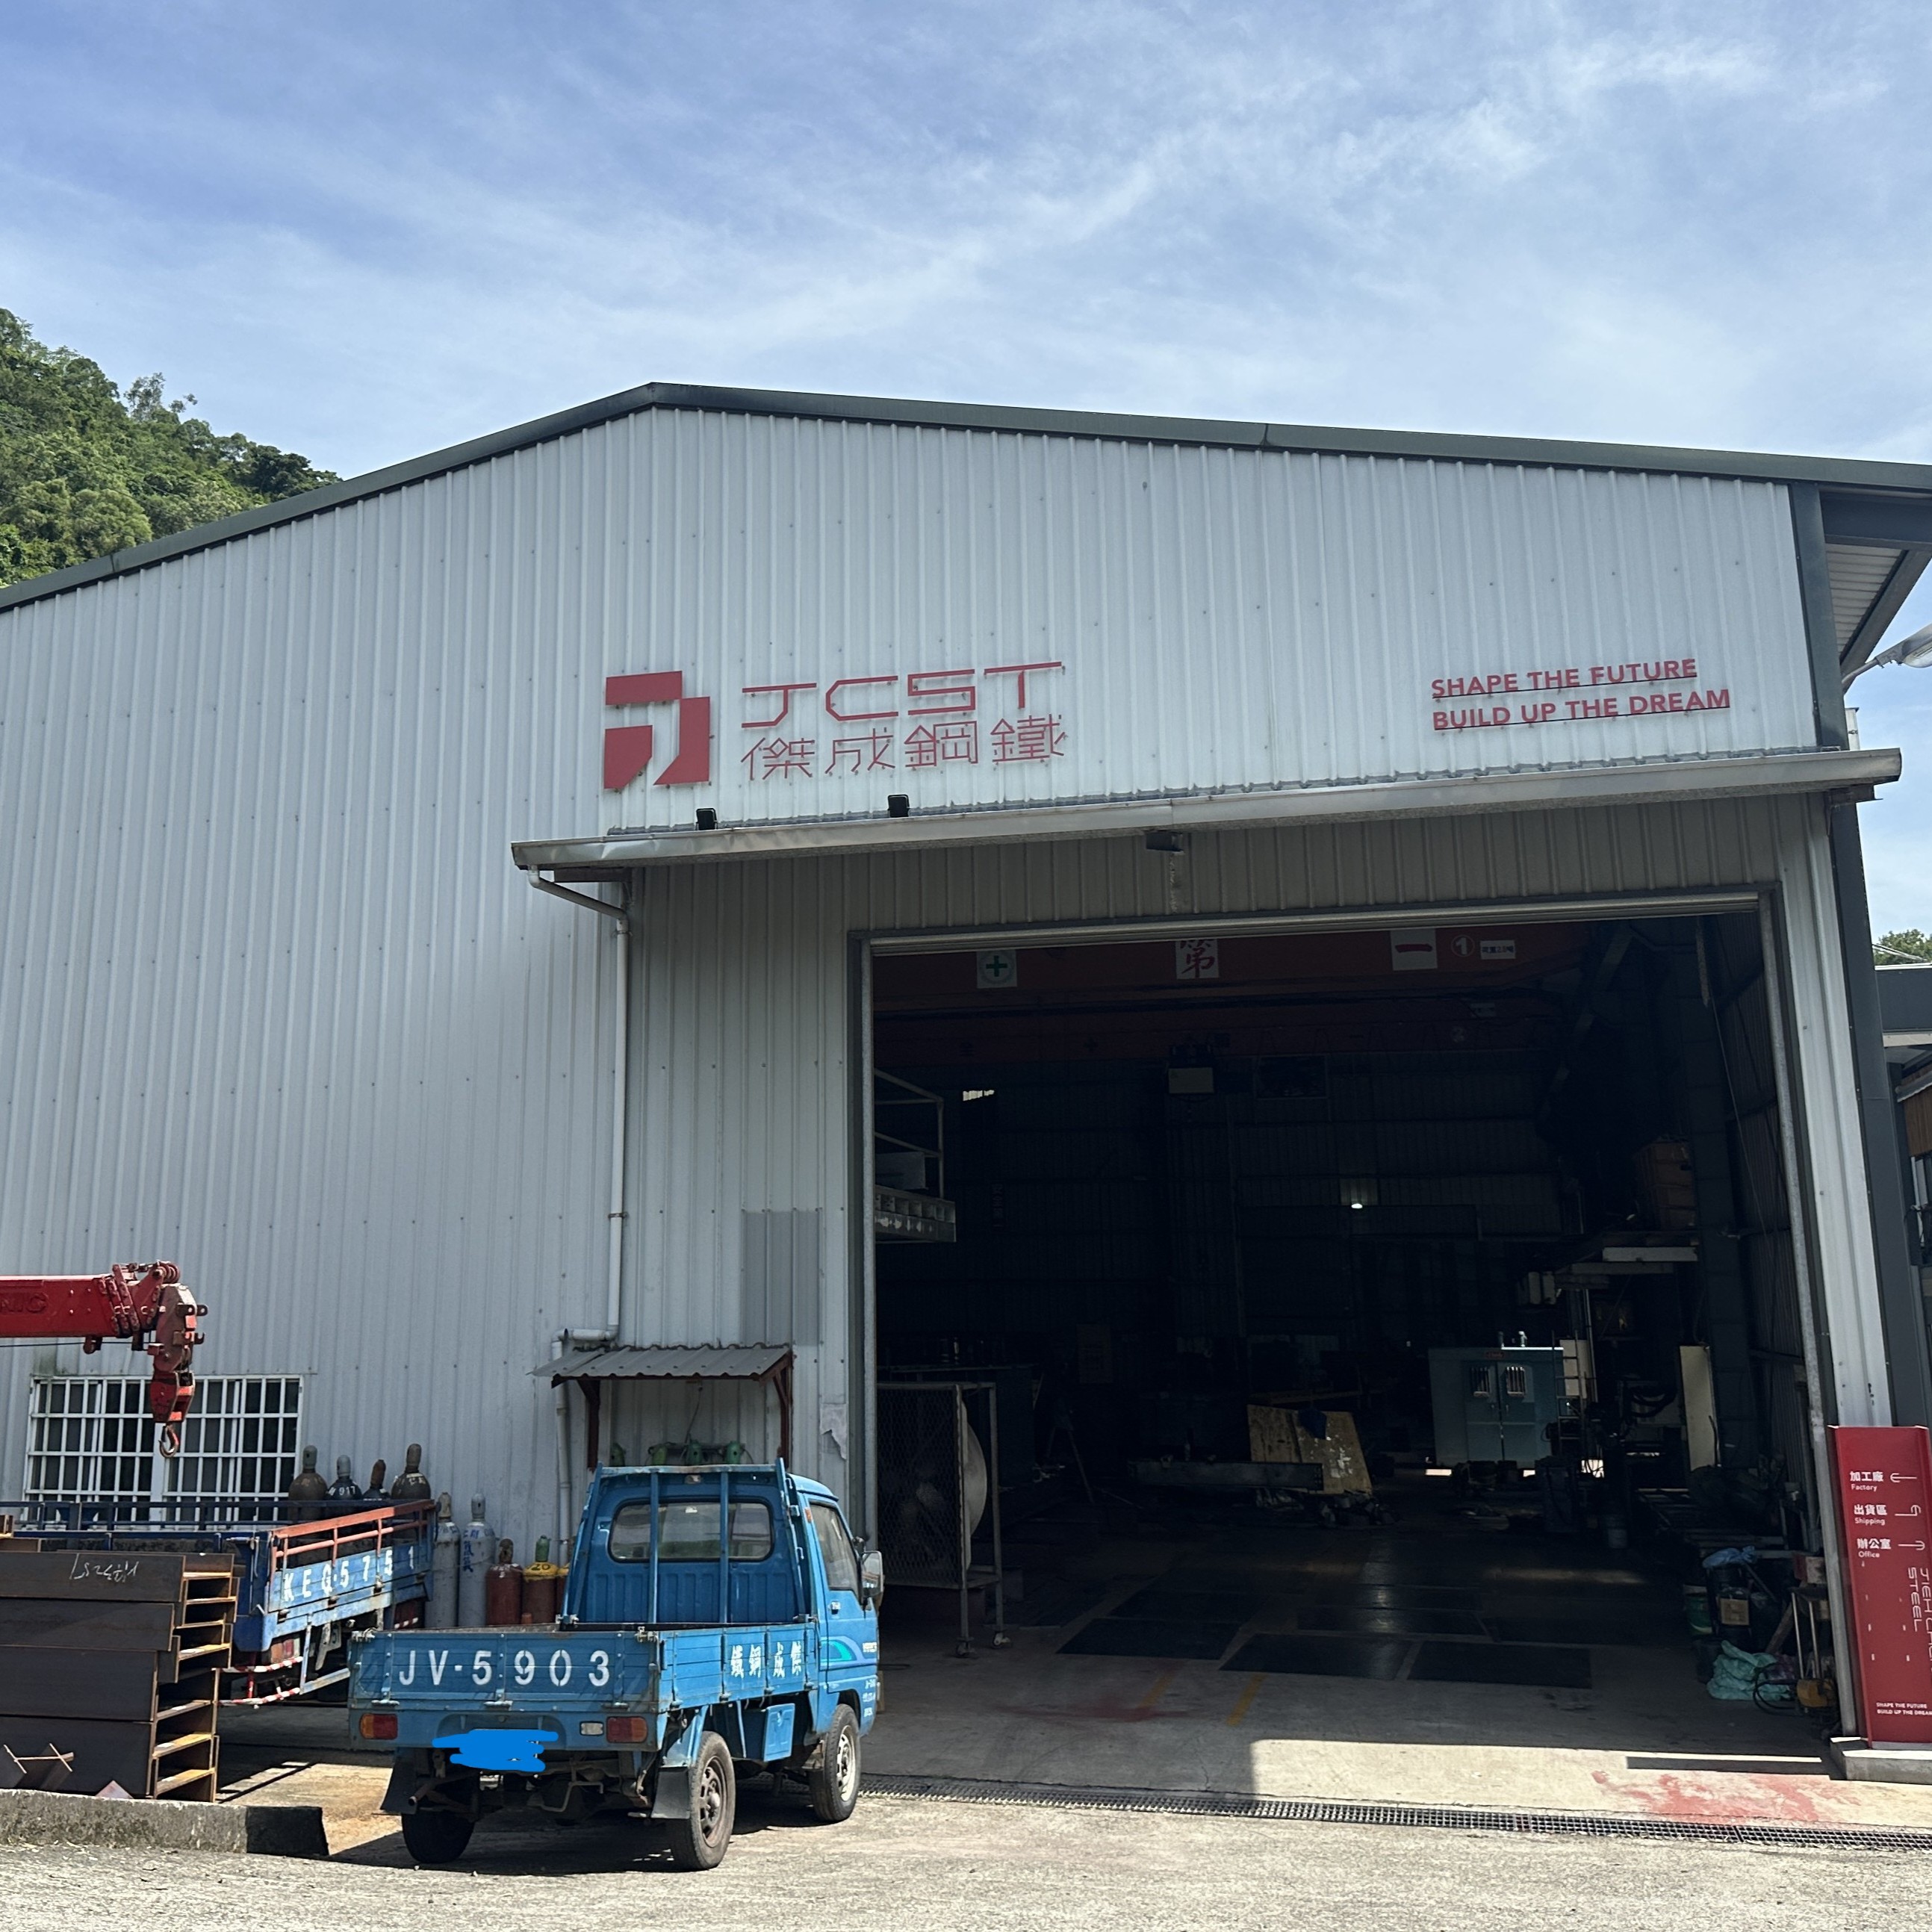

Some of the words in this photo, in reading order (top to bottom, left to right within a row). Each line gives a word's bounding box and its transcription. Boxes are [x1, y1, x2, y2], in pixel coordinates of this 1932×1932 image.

[1431, 673, 1518, 698] SHAPE
[1526, 668, 1580, 689] THE
[1591, 659, 1698, 685] FUTURE
[742, 662, 1062, 728] JCST
[1432, 706, 1511, 730] BUILD
[1521, 703, 1556, 723] UP
[1565, 698, 1619, 718] THE
[1630, 689, 1730, 714] DREAM
[741, 715, 1066, 780] 傑成鋼鐵
[1850, 1471, 1883, 1482] 加工廠
[1851, 1484, 1877, 1492] Factory
[1854, 1504, 1888, 1515] 出貨區
[1854, 1518, 1886, 1526] Shipping
[1857, 1538, 1891, 1550] 辦公室
[1908, 1567, 1923, 1633] STEEL
